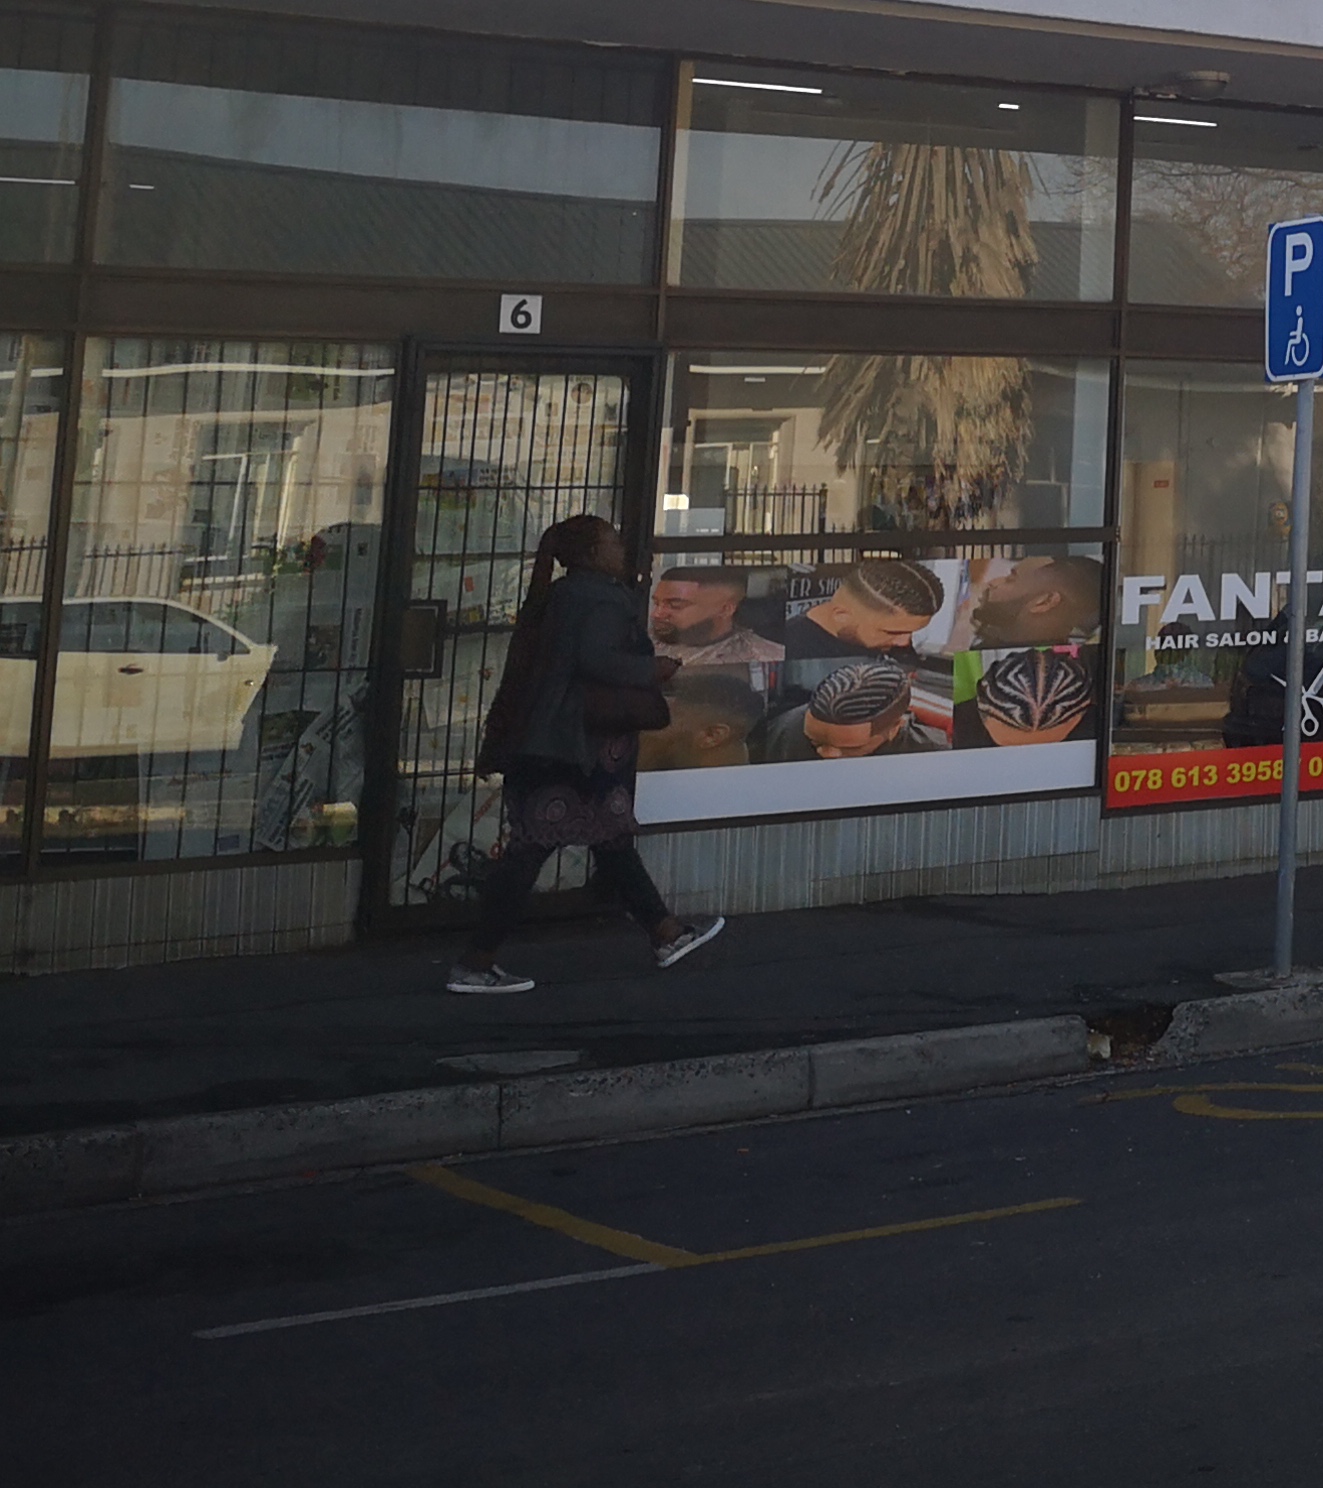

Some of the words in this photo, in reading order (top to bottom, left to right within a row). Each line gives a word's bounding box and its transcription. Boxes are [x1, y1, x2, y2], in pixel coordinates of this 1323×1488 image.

[1284, 232, 1314, 297] P
[510, 299, 532, 329] 6
[1146, 632, 1199, 651] HAIR
[1205, 630, 1277, 648] SALON
[1114, 769, 1162, 793] 078
[1171, 764, 1219, 788] 613
[1226, 759, 1285, 785] 3958
